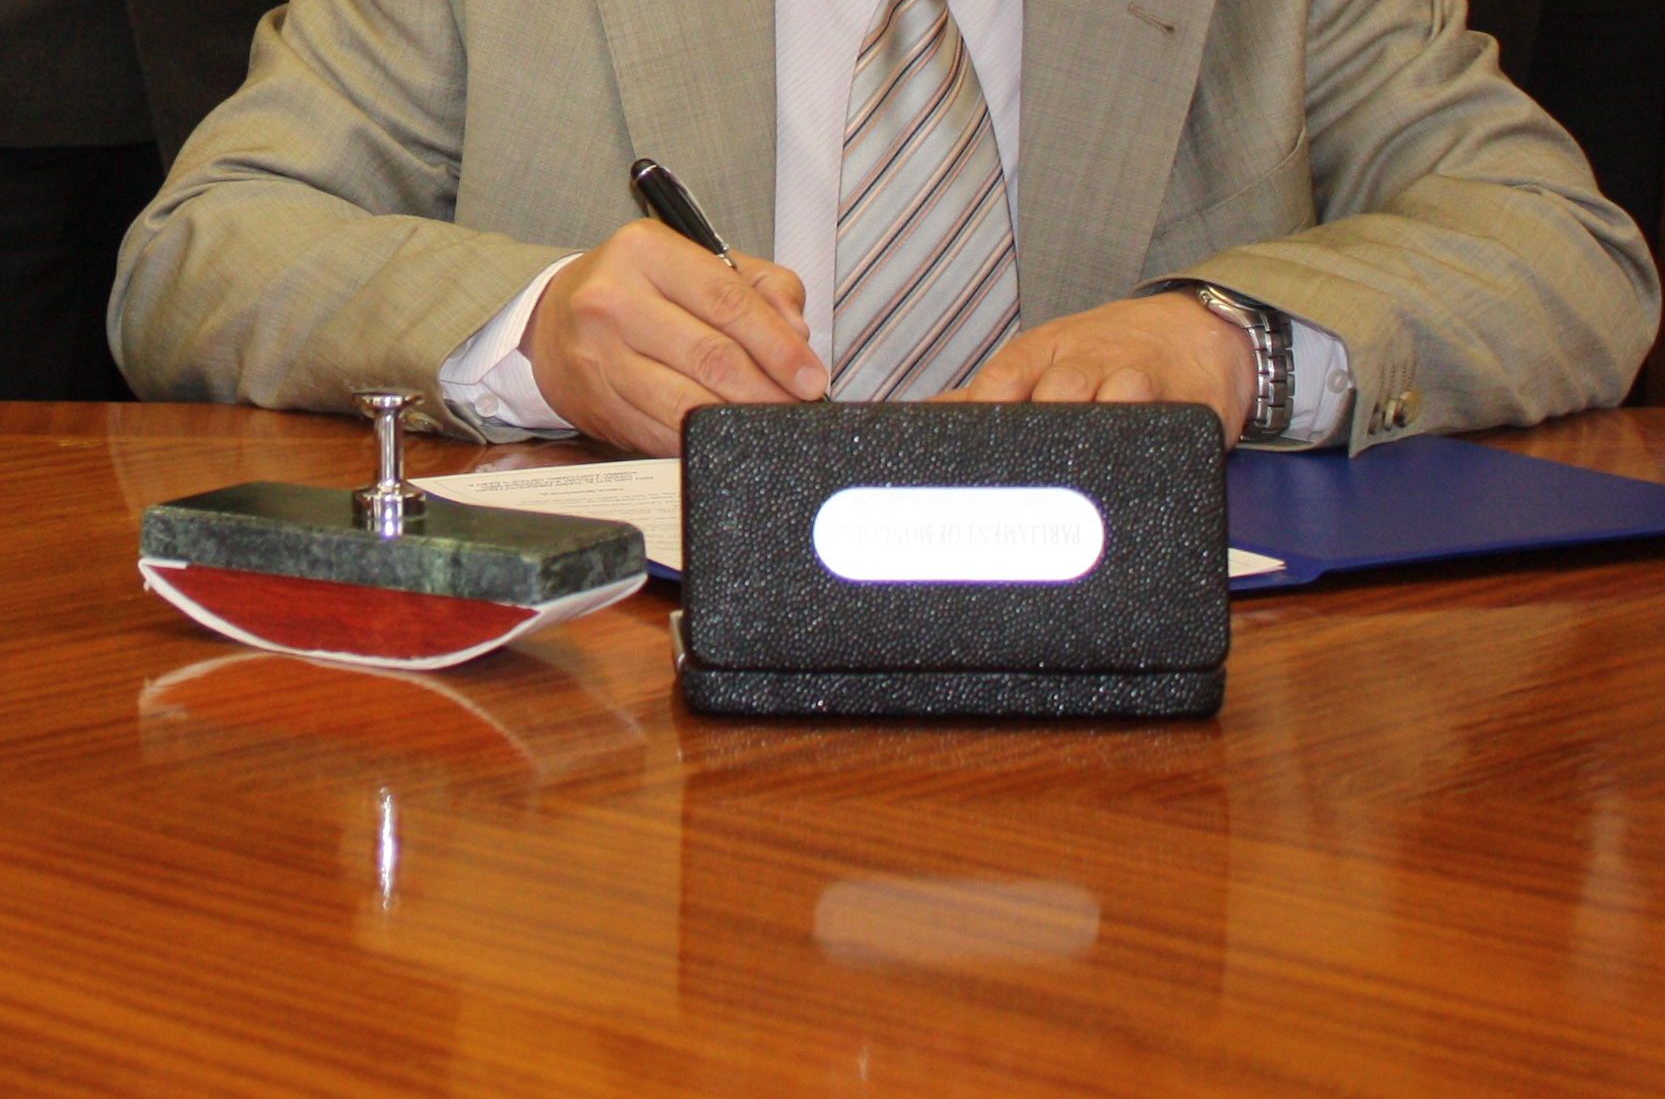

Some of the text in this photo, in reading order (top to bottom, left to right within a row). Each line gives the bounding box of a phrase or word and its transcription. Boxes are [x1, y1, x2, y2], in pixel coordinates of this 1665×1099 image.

[834, 524, 1082, 544] PARLIAMENT OF MONGOLIA
